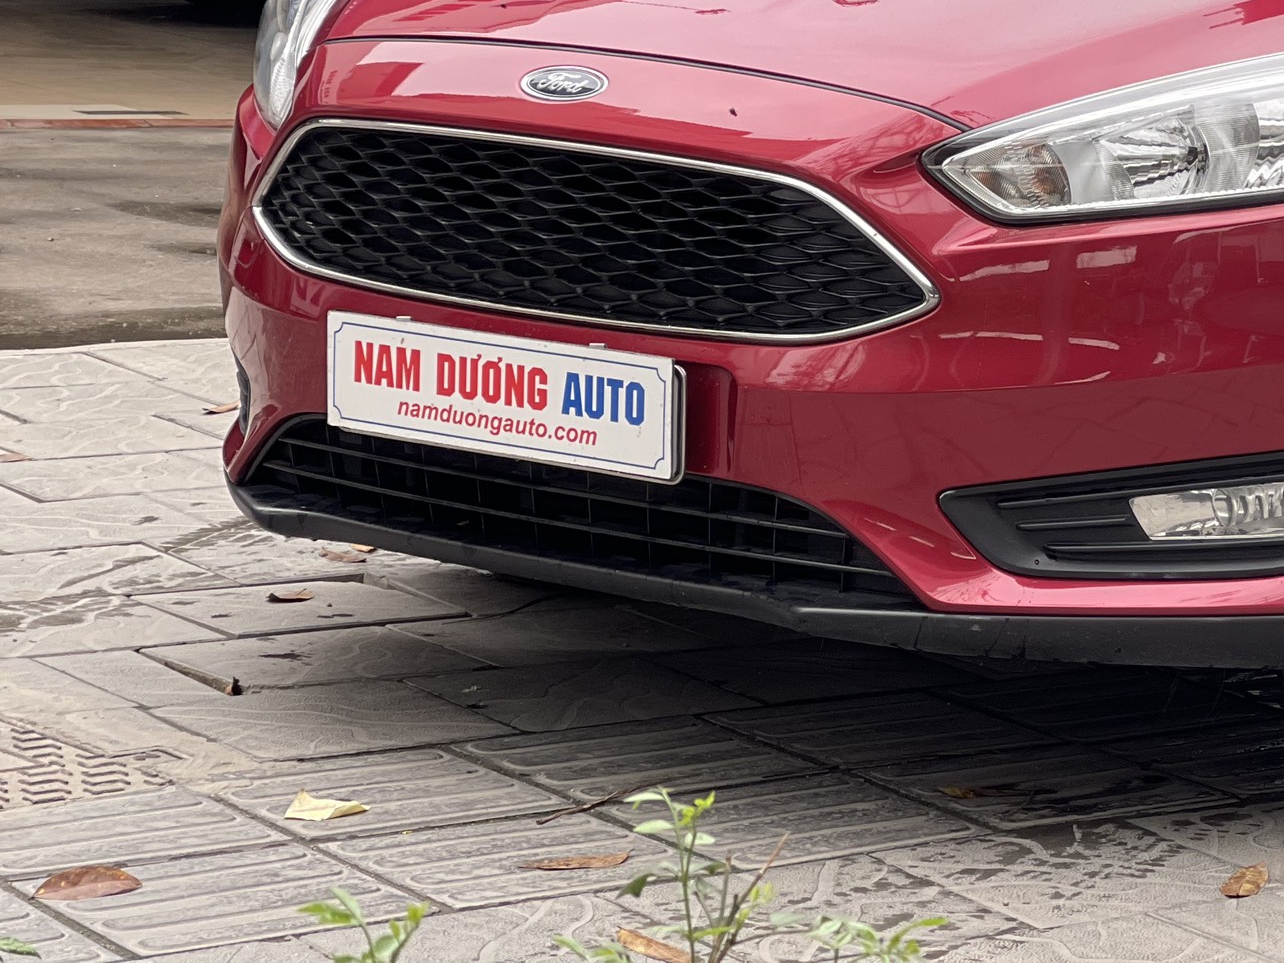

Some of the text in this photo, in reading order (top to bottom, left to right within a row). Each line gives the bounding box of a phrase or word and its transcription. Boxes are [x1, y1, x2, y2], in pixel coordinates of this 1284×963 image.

[536, 72, 590, 94] Ford
[353, 340, 646, 427] NAM DƯƠNG AUTO
[397, 398, 598, 447] namduongauto.com
